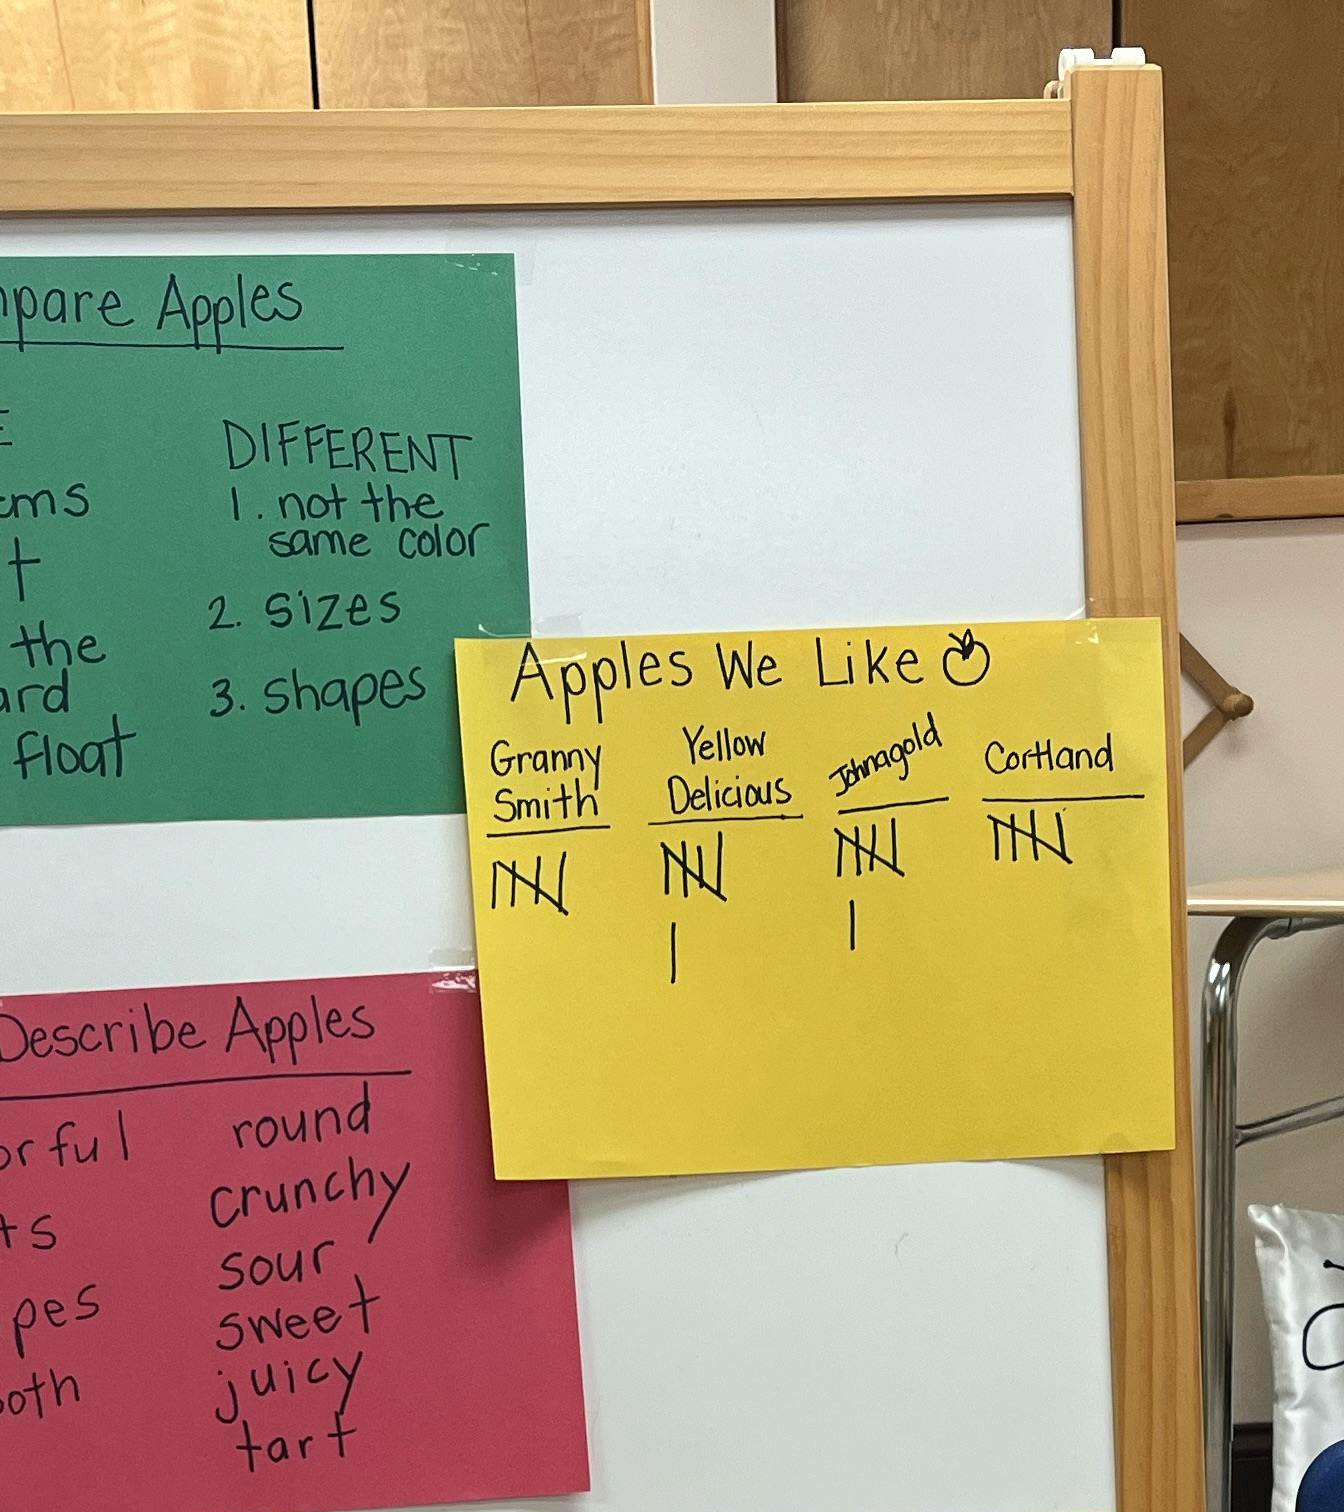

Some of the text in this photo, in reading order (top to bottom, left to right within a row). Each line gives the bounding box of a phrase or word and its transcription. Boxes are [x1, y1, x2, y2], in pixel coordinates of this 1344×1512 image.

[156, 274, 304, 354] Apples
[223, 419, 472, 480] DIFFERENT
[232, 486, 445, 522] 1. not the
[268, 521, 490, 559] same color
[208, 588, 400, 631] 2. sizes
[10, 620, 106, 667] the
[210, 663, 426, 726] 3. shapes
[510, 637, 924, 725] Apples We Like
[14, 714, 136, 778] float
[489, 739, 602, 790] Granny
[681, 726, 766, 762] Yellow
[984, 734, 1114, 775] Cortland
[494, 787, 599, 823] Smith
[668, 775, 792, 815] Delicious
[224, 996, 375, 1064] Apples
[232, 1081, 371, 1149] round
[210, 1157, 410, 1244] crunchy
[218, 1239, 335, 1291] sour
[216, 1274, 380, 1352] sweet
[214, 1351, 364, 1424] juicy
[236, 1410, 357, 1472] tart
